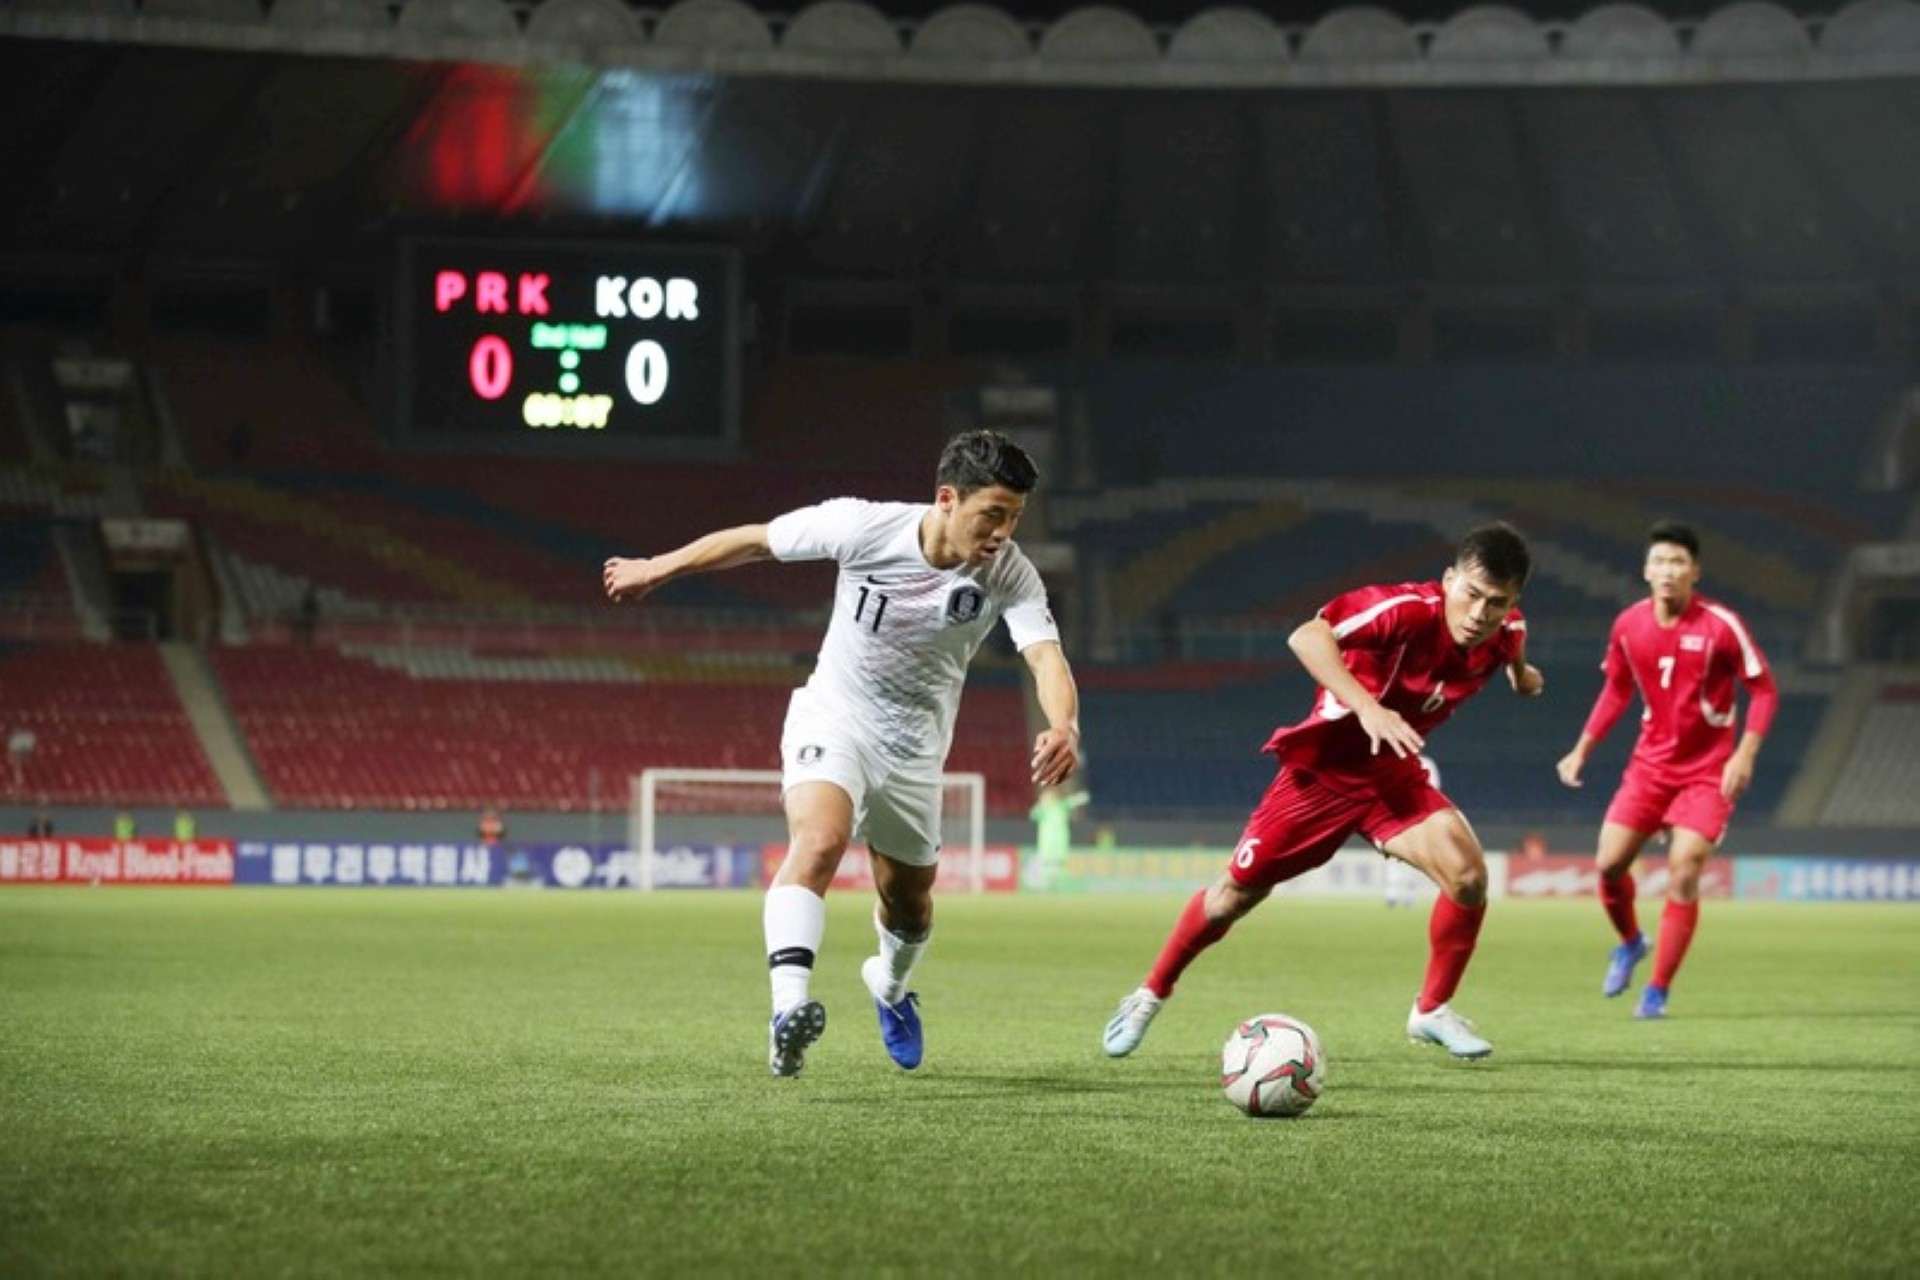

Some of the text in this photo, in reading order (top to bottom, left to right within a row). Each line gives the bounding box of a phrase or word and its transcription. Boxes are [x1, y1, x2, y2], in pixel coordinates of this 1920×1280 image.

[435, 270, 698, 320] PRK KOR
[469, 334, 512, 400] 0
[625, 339, 668, 405] 0
[855, 586, 888, 633] 11
[1421, 680, 1444, 712] 6
[1658, 656, 1675, 689] 7
